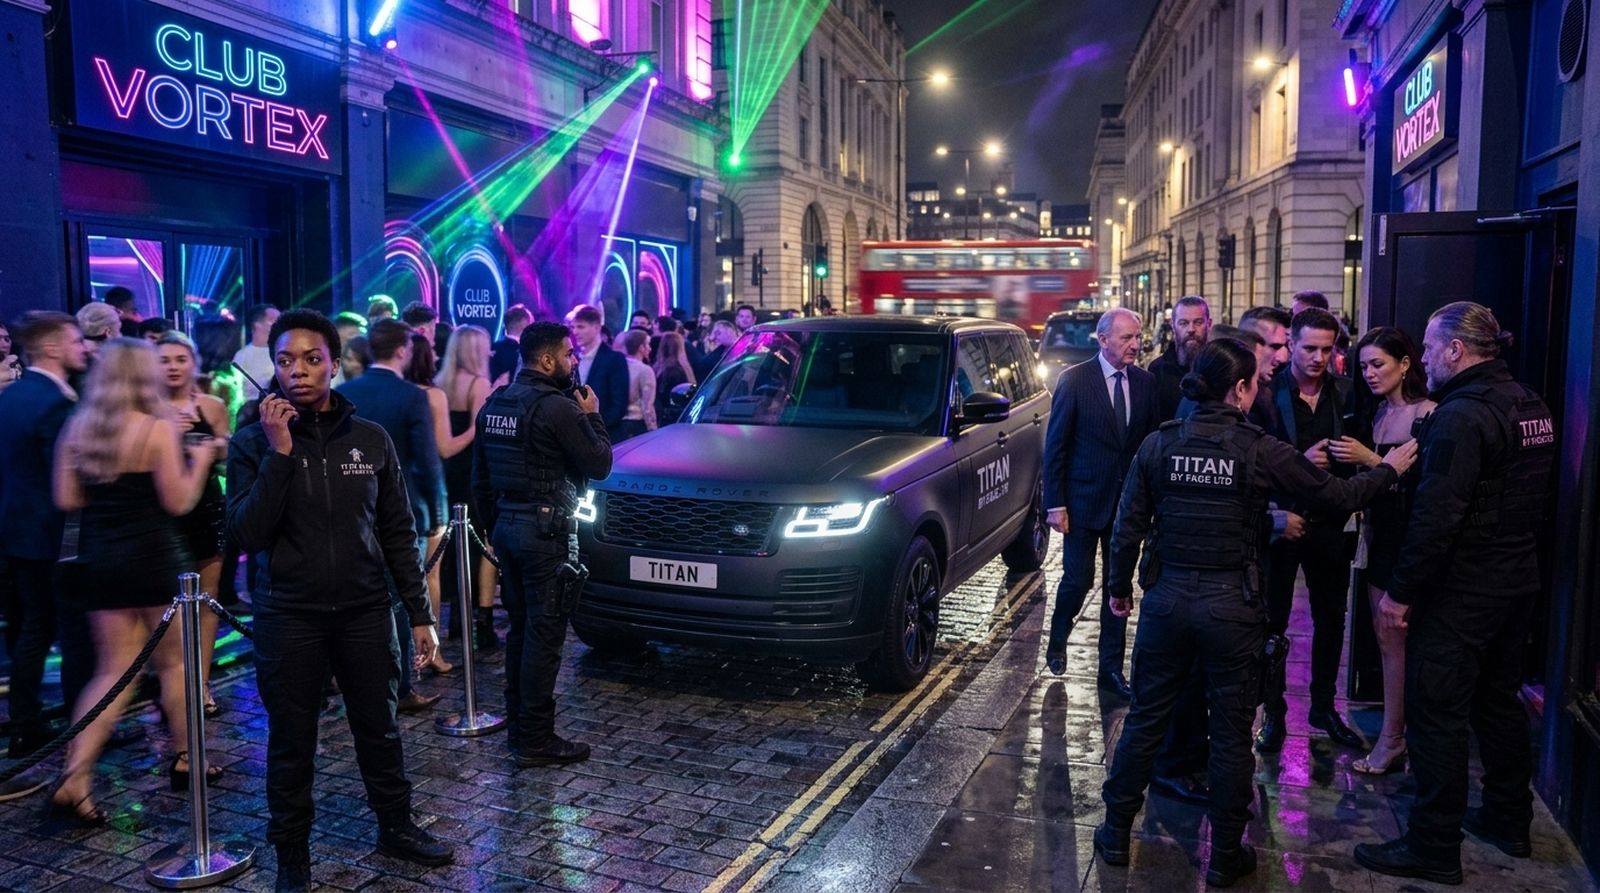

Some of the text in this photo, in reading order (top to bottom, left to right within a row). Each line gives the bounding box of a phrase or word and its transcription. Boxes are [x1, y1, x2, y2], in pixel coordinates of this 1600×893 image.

[156, 24, 287, 96] CLUB
[1404, 61, 1433, 116] CLUB
[94, 57, 330, 160] VORTEX
[1395, 89, 1441, 163] VORTEX
[465, 288, 490, 303] CLUB
[457, 303, 497, 318] VORTEX
[485, 414, 517, 429] TITAN
[1519, 418, 1553, 437] TITAN
[977, 453, 1010, 494] TITAN
[1171, 455, 1235, 476] TITAN
[1170, 472, 1183, 481] BY
[1213, 476, 1233, 486] LTD
[648, 561, 698, 583] TITAN
